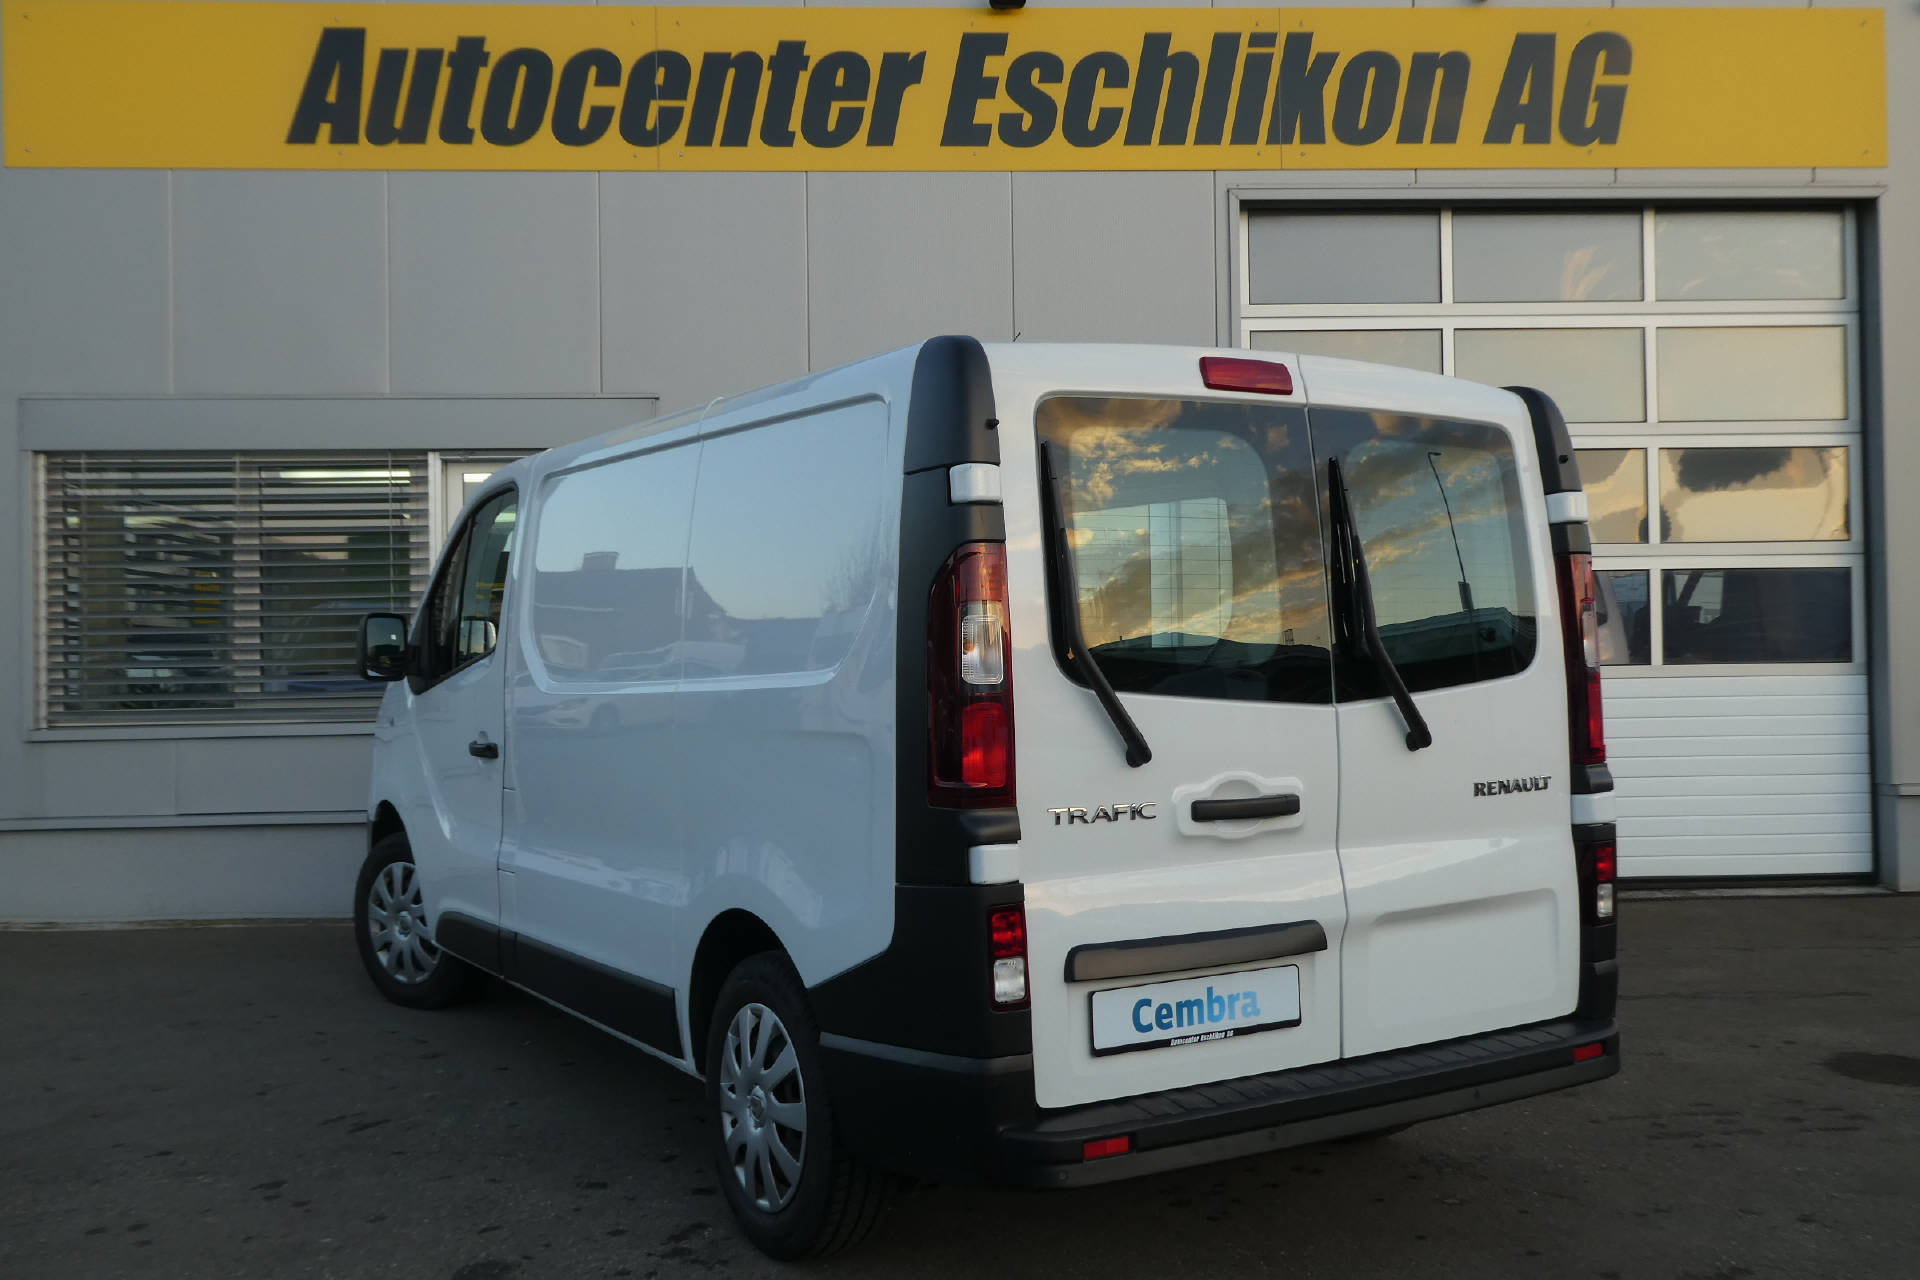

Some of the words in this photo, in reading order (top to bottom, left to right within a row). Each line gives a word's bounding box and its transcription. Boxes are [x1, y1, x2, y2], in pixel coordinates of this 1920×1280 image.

[285, 27, 927, 148] Autocenter
[940, 32, 1471, 148] Eschlikon
[1482, 31, 1633, 147] AG
[1473, 775, 1552, 797] RENAULT
[1047, 801, 1158, 826] TRAFIC
[1132, 986, 1261, 1034] Cembra
